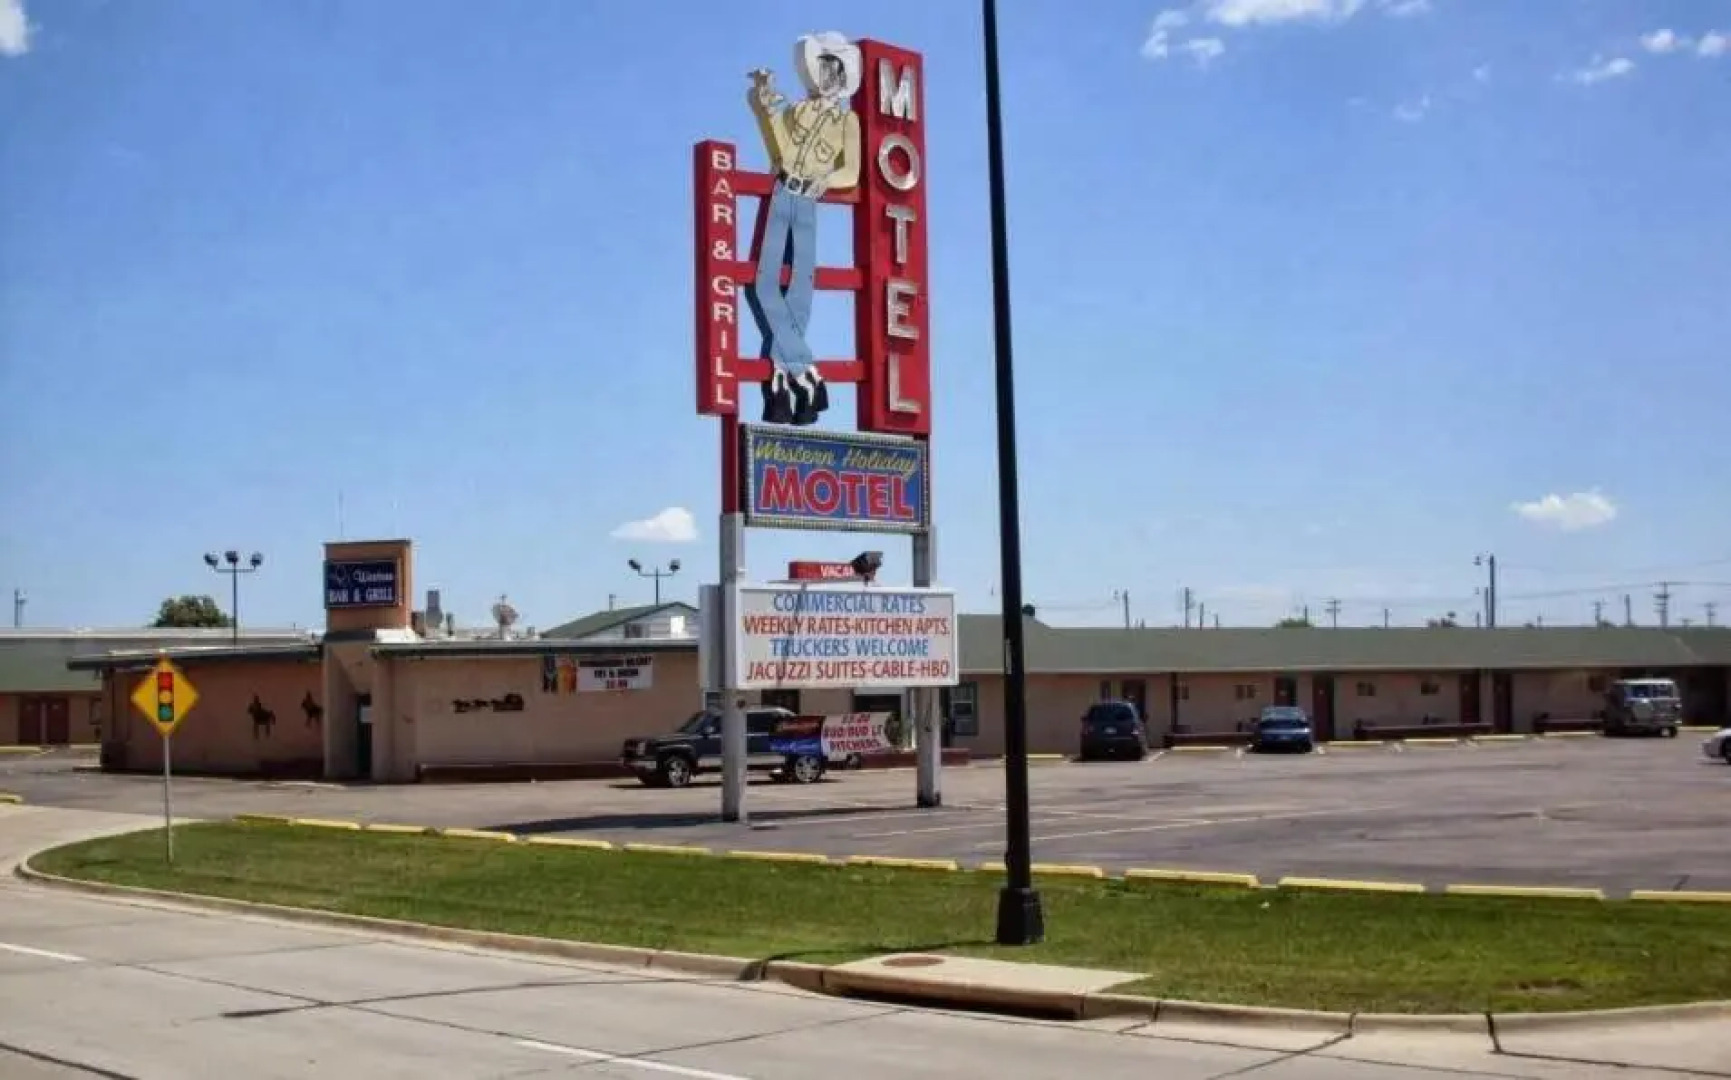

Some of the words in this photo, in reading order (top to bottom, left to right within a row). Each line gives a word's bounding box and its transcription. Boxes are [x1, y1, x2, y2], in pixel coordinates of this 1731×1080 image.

[711, 150, 733, 225] BAR
[877, 58, 920, 413] MOTEL
[711, 239, 732, 261] &
[711, 274, 734, 406] GRILL
[755, 440, 835, 466] Western
[842, 449, 918, 480] Holiday
[760, 464, 914, 519] MOTEL
[365, 586, 393, 601] GRILL
[773, 592, 878, 613] COMMERCIAL
[883, 594, 926, 614] RATES
[744, 615, 802, 635] WEEKLY
[807, 616, 913, 635] RATES-KITCHEN
[916, 617, 950, 635] APTS.
[770, 638, 850, 657] TRUCKERS
[856, 638, 929, 657] WELCOME
[747, 661, 812, 681] JACUZZI
[816, 660, 950, 680] SUITES-CABLE-HBO
